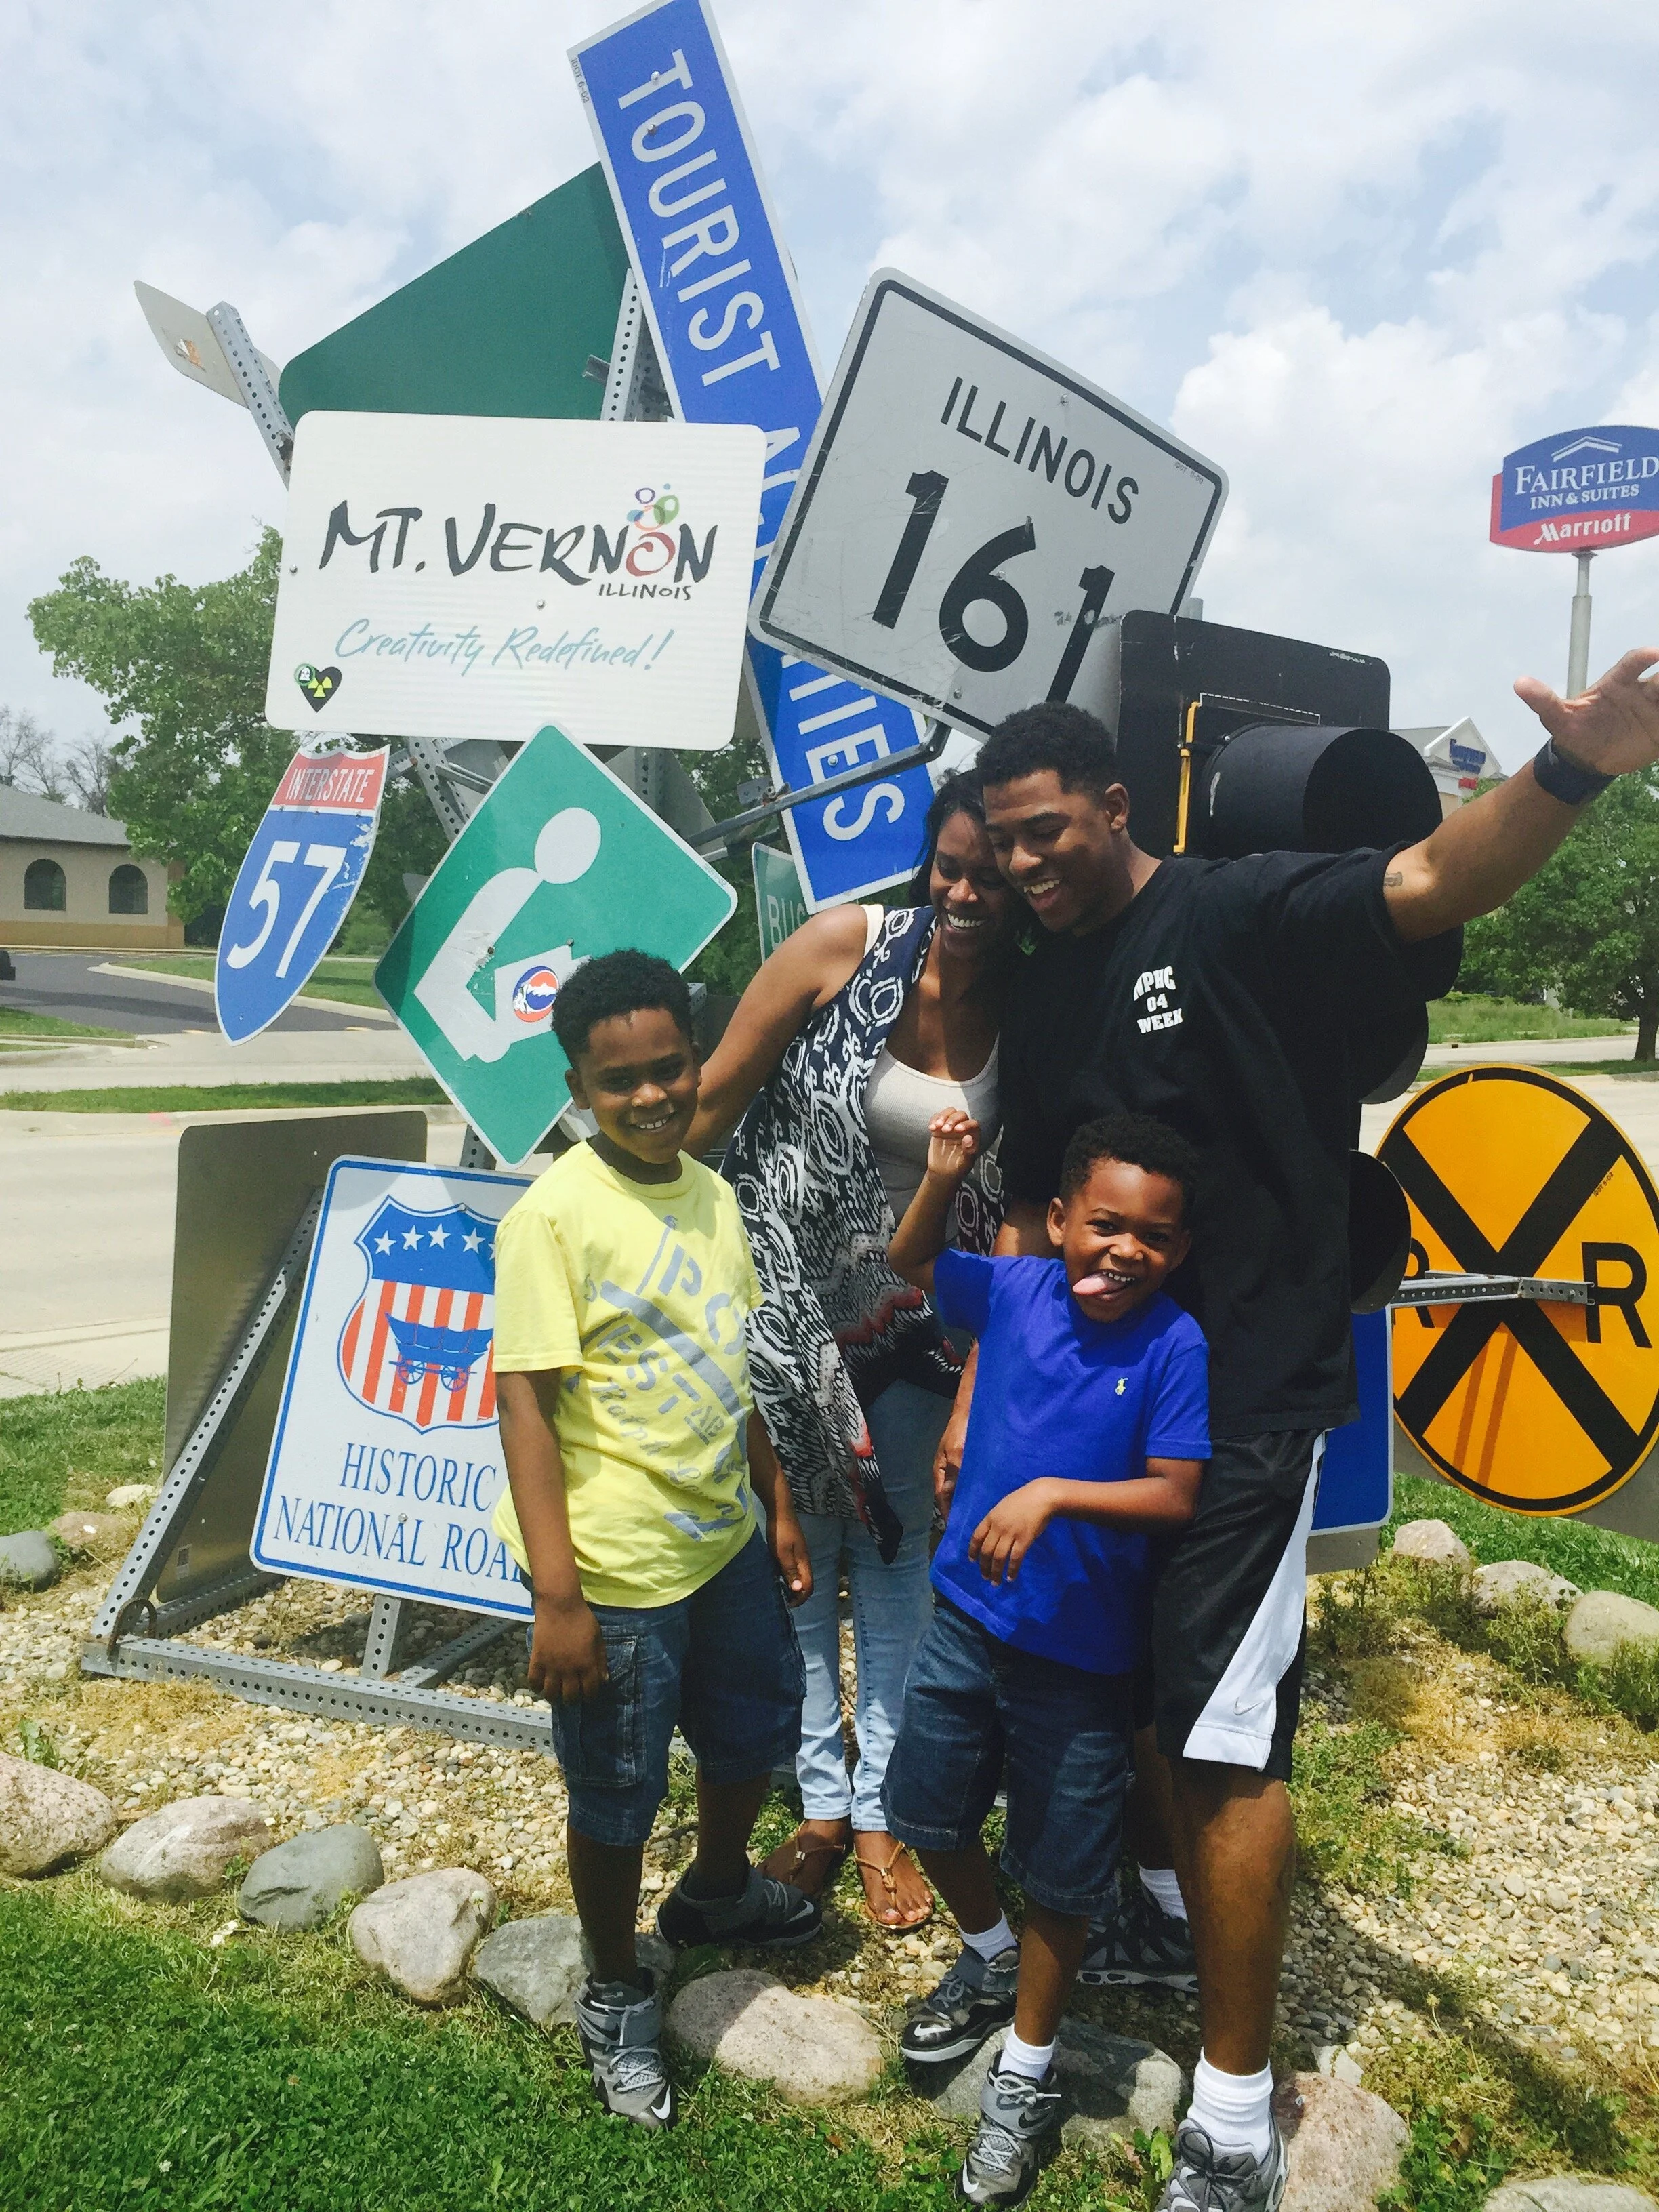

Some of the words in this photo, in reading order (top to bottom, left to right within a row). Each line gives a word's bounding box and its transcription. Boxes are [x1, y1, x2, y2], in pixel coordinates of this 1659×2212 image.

[571, 58, 582, 78] IDOT
[577, 81, 590, 104] 6-02
[617, 49, 781, 387] TOURIST
[940, 377, 1139, 525] ILLINOIS
[1515, 456, 1659, 495] FAIRFIELD
[1530, 493, 1563, 510] INN
[1565, 492, 1579, 505] &
[1581, 484, 1639, 503] SUITES
[1534, 512, 1632, 545] Marriott
[319, 499, 426, 573] MT.
[445, 503, 718, 586] VERNON
[872, 470, 1115, 703] 161
[334, 618, 483, 676] Creativity
[491, 626, 676, 676] Redefined!
[285, 767, 375, 804] INTERSTATE
[226, 840, 348, 979] 57
[1136, 1008, 1184, 1034] WEEK
[1581, 1242, 1652, 1348] R
[340, 1442, 497, 1511] HISTORIC
[272, 1495, 427, 1568] NATIONAL
